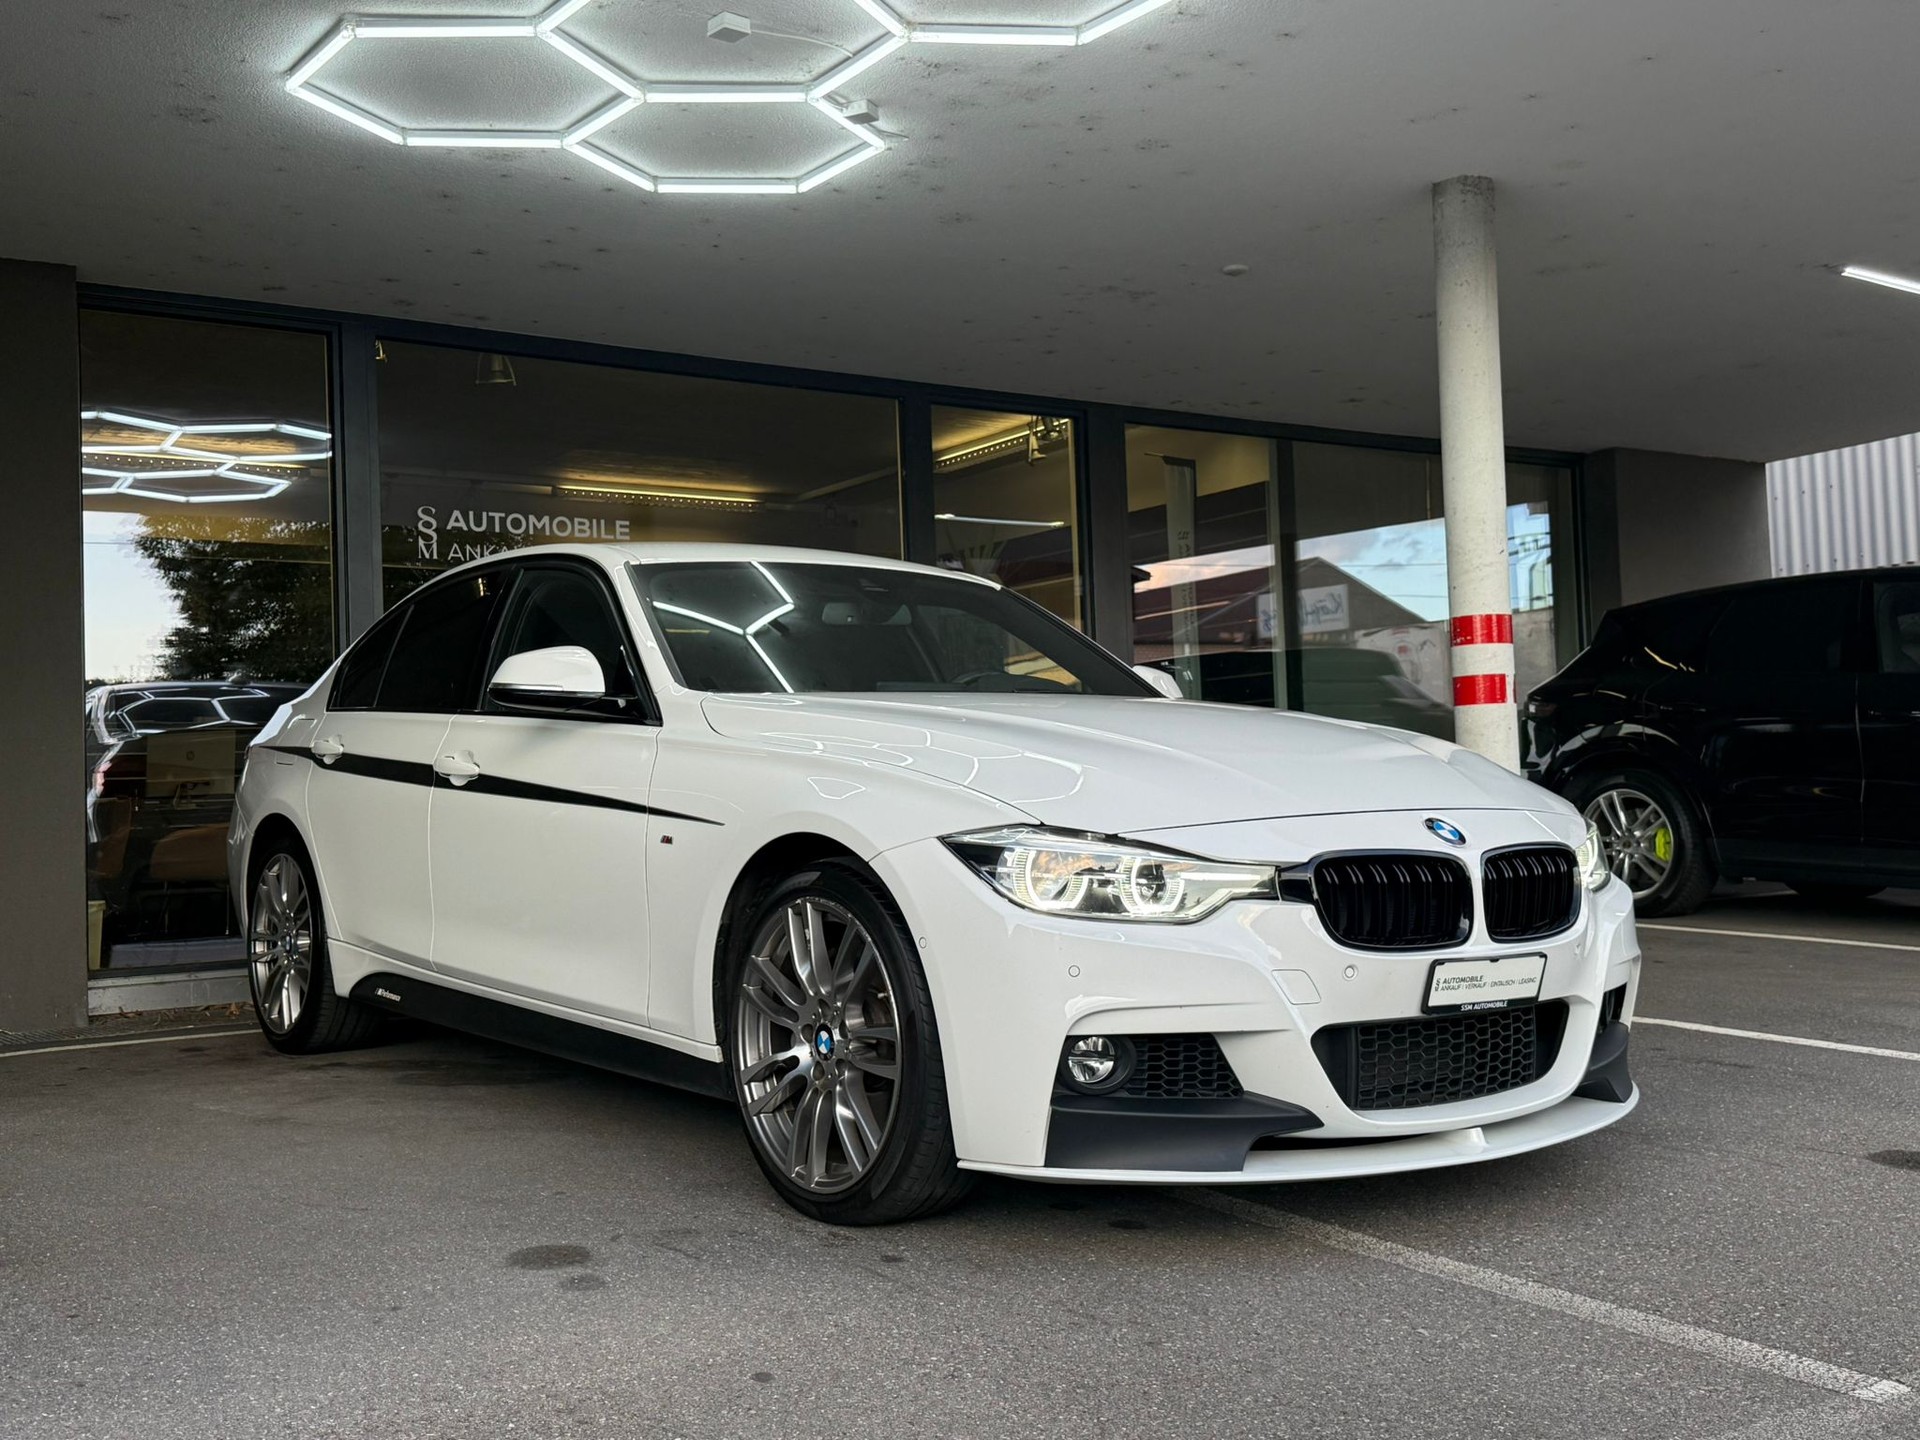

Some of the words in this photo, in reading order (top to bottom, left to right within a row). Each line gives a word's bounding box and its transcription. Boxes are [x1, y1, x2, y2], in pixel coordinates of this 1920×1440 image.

[446, 509, 631, 540] AUTOMOBILE
[1442, 975, 1484, 984] AUTOMOBILE
[1465, 982, 1487, 990] VERKAUF
[1473, 1000, 1508, 1010] AUTOMOBILE
